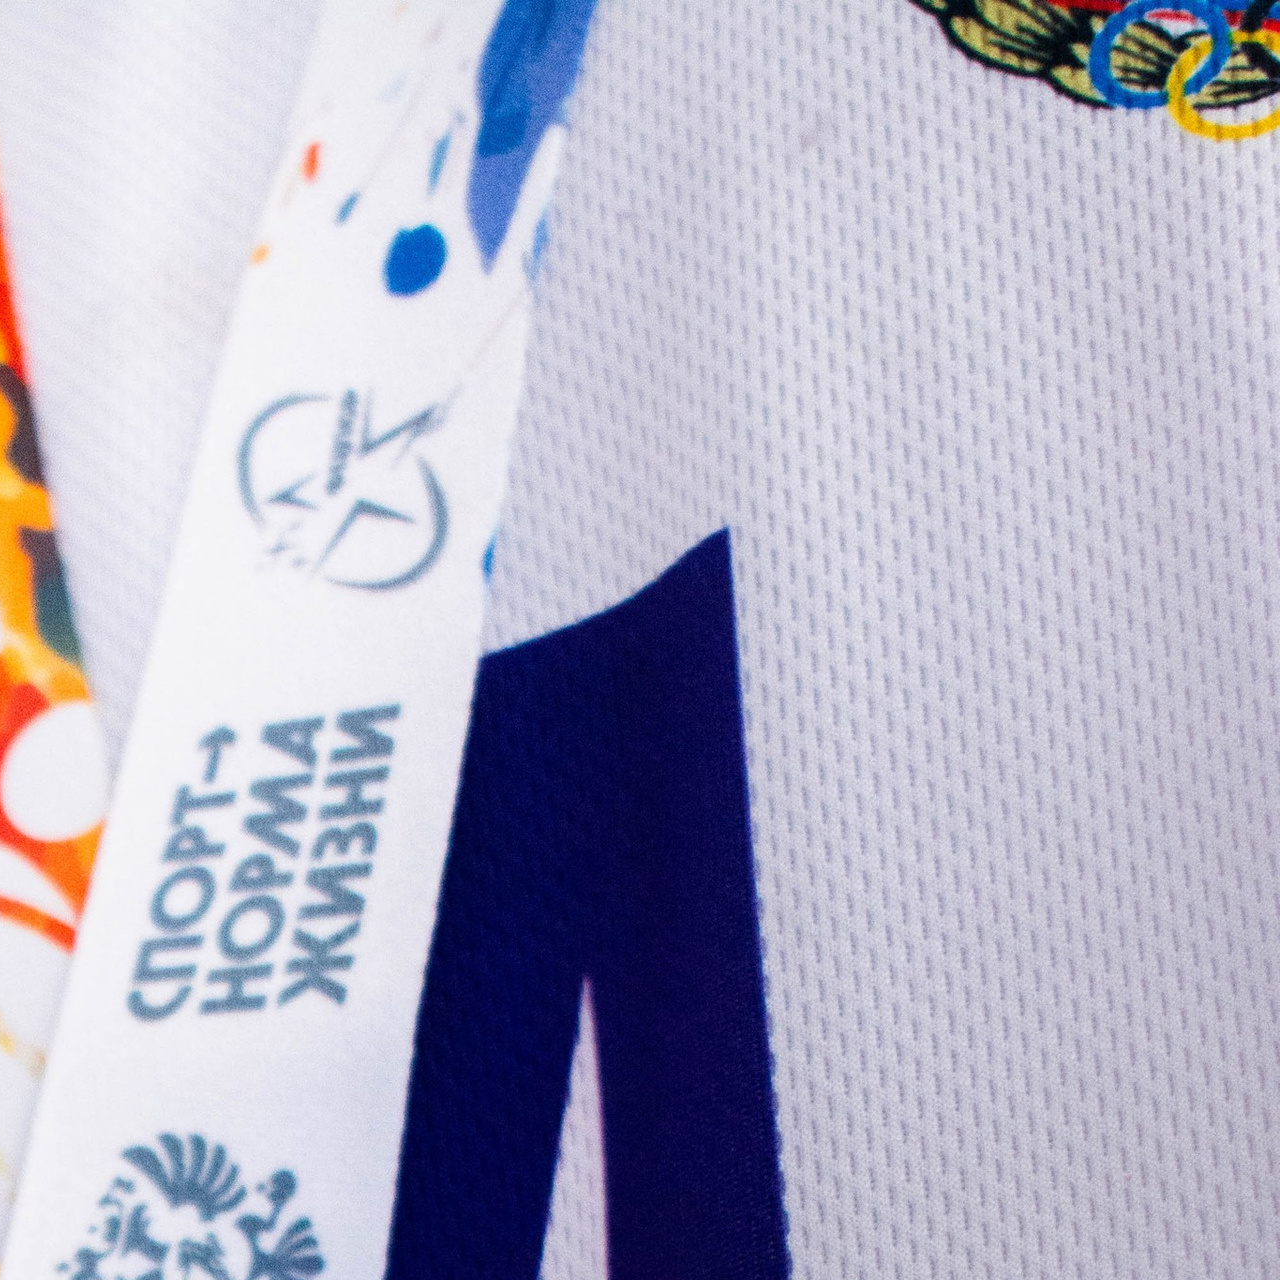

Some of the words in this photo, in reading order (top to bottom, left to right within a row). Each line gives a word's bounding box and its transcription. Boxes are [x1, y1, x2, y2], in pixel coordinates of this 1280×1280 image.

[126, 784, 237, 1022] СПОРТ
[198, 714, 325, 1015] НОРМА
[277, 702, 402, 1006] ЖИЗНИ
